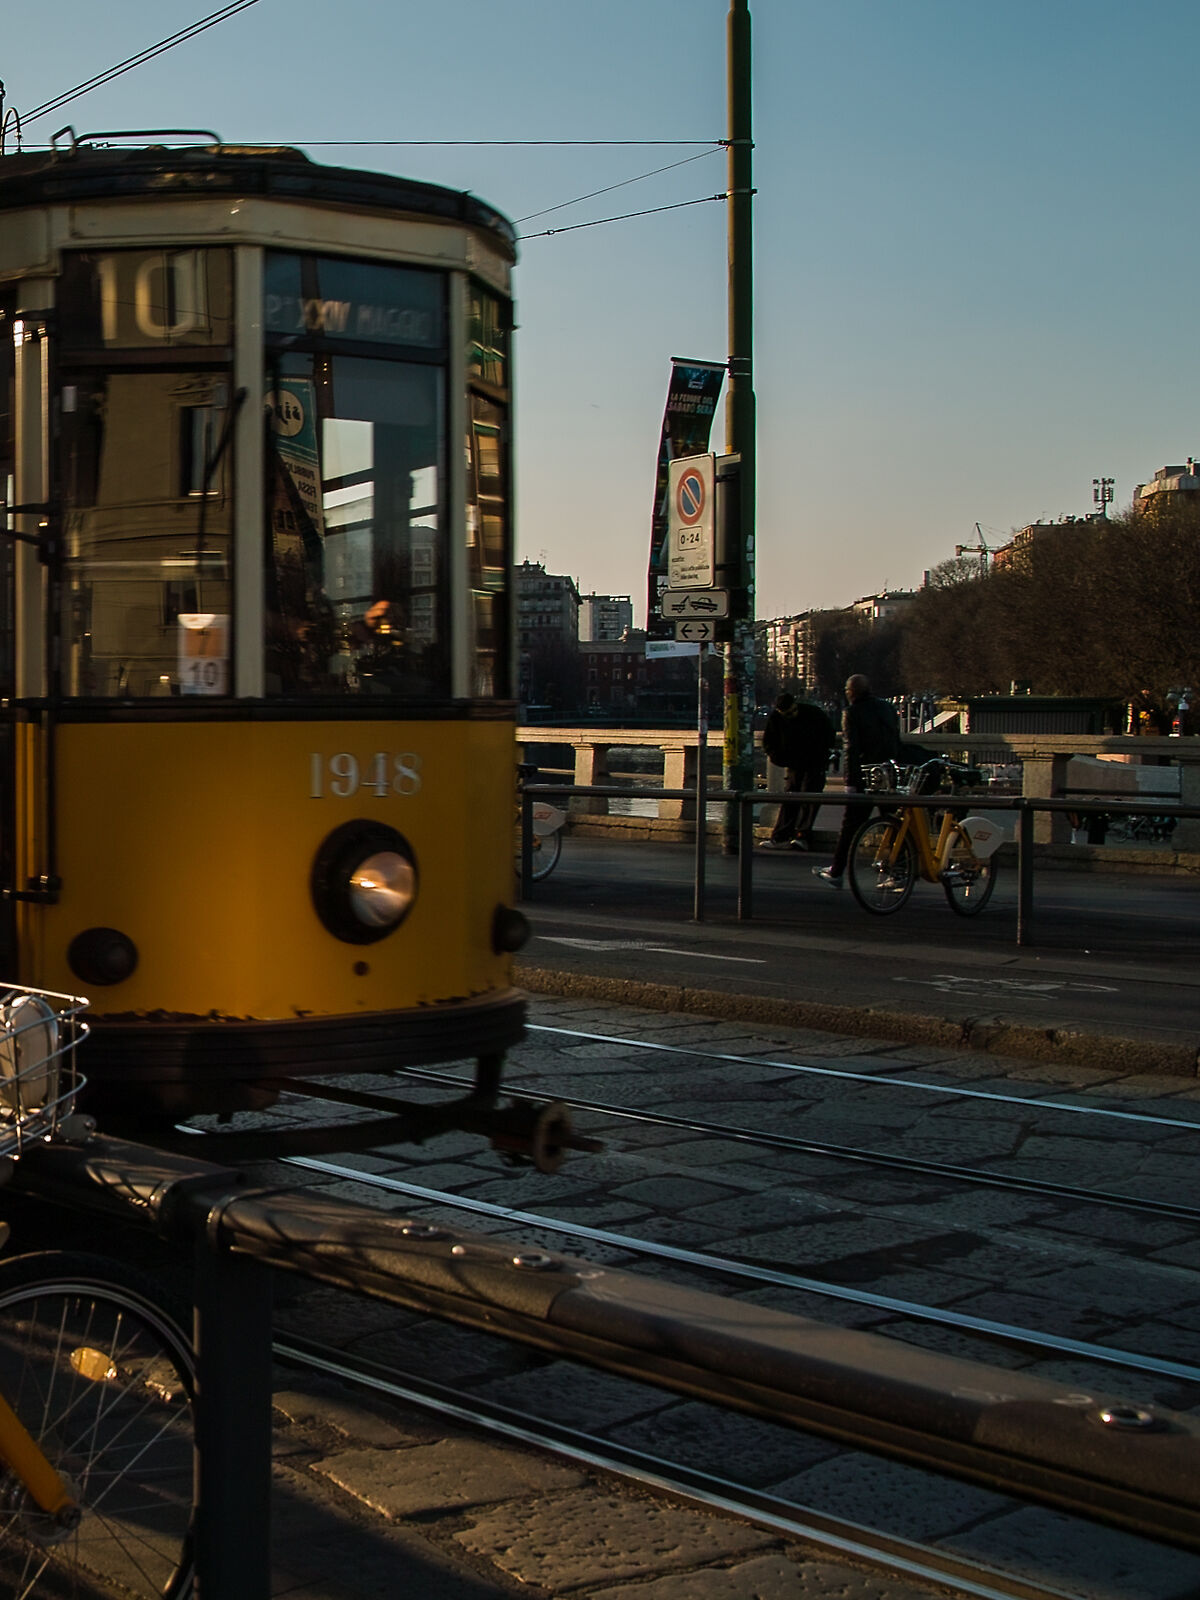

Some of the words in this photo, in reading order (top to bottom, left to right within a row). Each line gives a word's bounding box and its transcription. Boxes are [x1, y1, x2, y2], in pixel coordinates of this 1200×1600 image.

[98, 256, 197, 340] 10
[189, 661, 218, 687] 10
[308, 751, 422, 799] 1948
